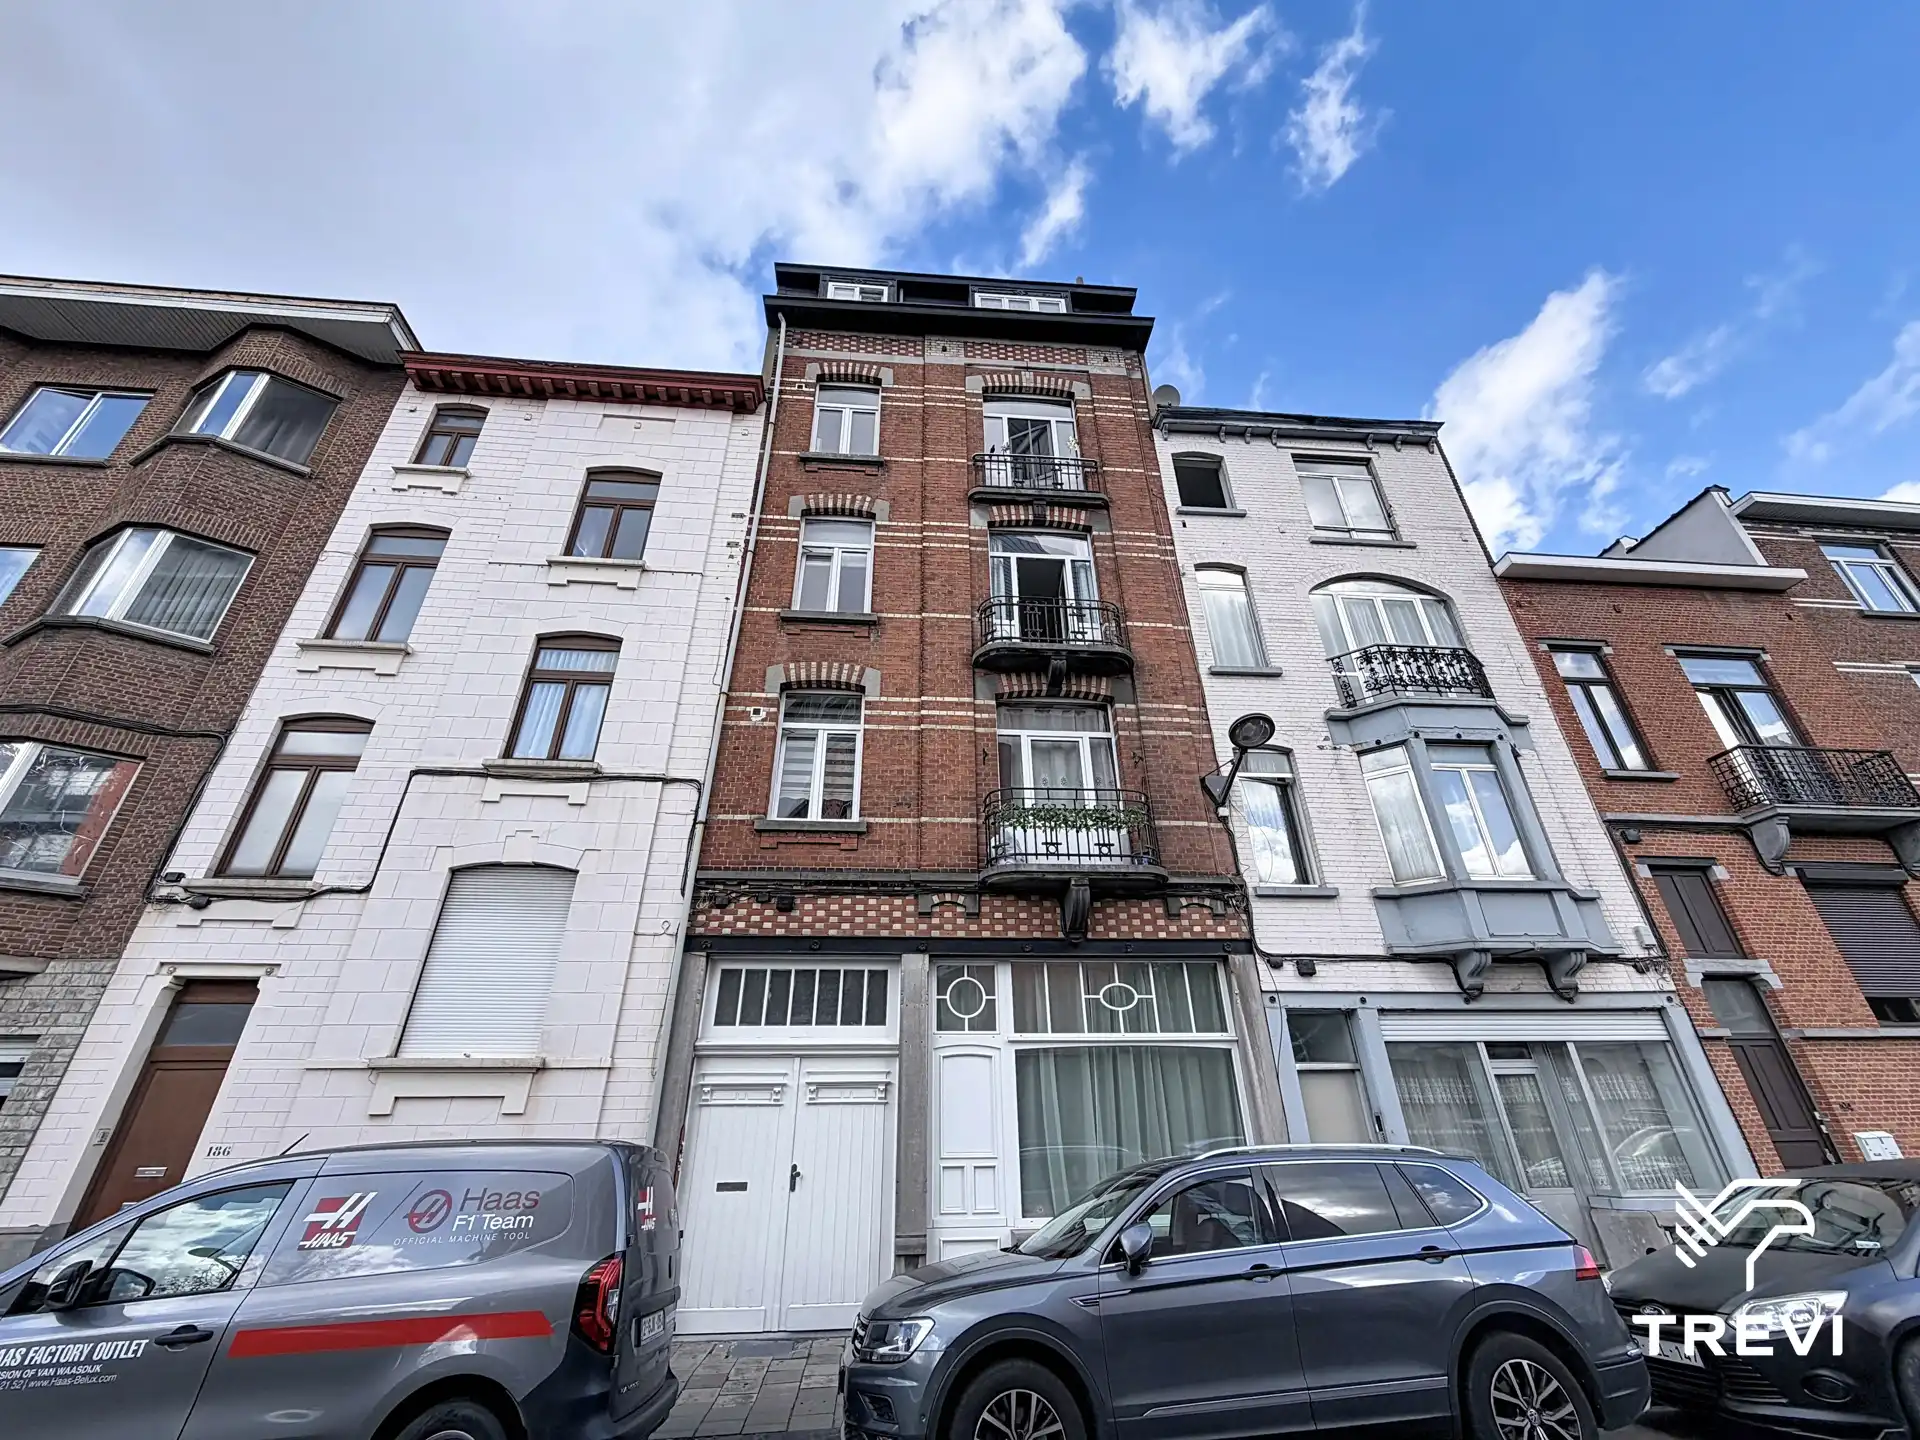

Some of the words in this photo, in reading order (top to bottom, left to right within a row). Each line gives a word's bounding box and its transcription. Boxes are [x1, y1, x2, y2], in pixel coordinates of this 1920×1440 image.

[206, 1146, 231, 1157] 186
[459, 1188, 540, 1212] Haas
[481, 1212, 535, 1231] Team
[299, 1231, 357, 1249] HAAS
[393, 1236, 443, 1246] OFFICIAL
[448, 1232, 498, 1243] MACHINE
[503, 1231, 530, 1240] TOOL
[23, 1342, 94, 1365] FACTORY
[92, 1339, 149, 1361] OUTLET
[22, 1368, 37, 1378] OF
[37, 1367, 55, 1377] VAN
[57, 1364, 103, 1376] WAASDIJK
[10, 1379, 24, 1390] 52
